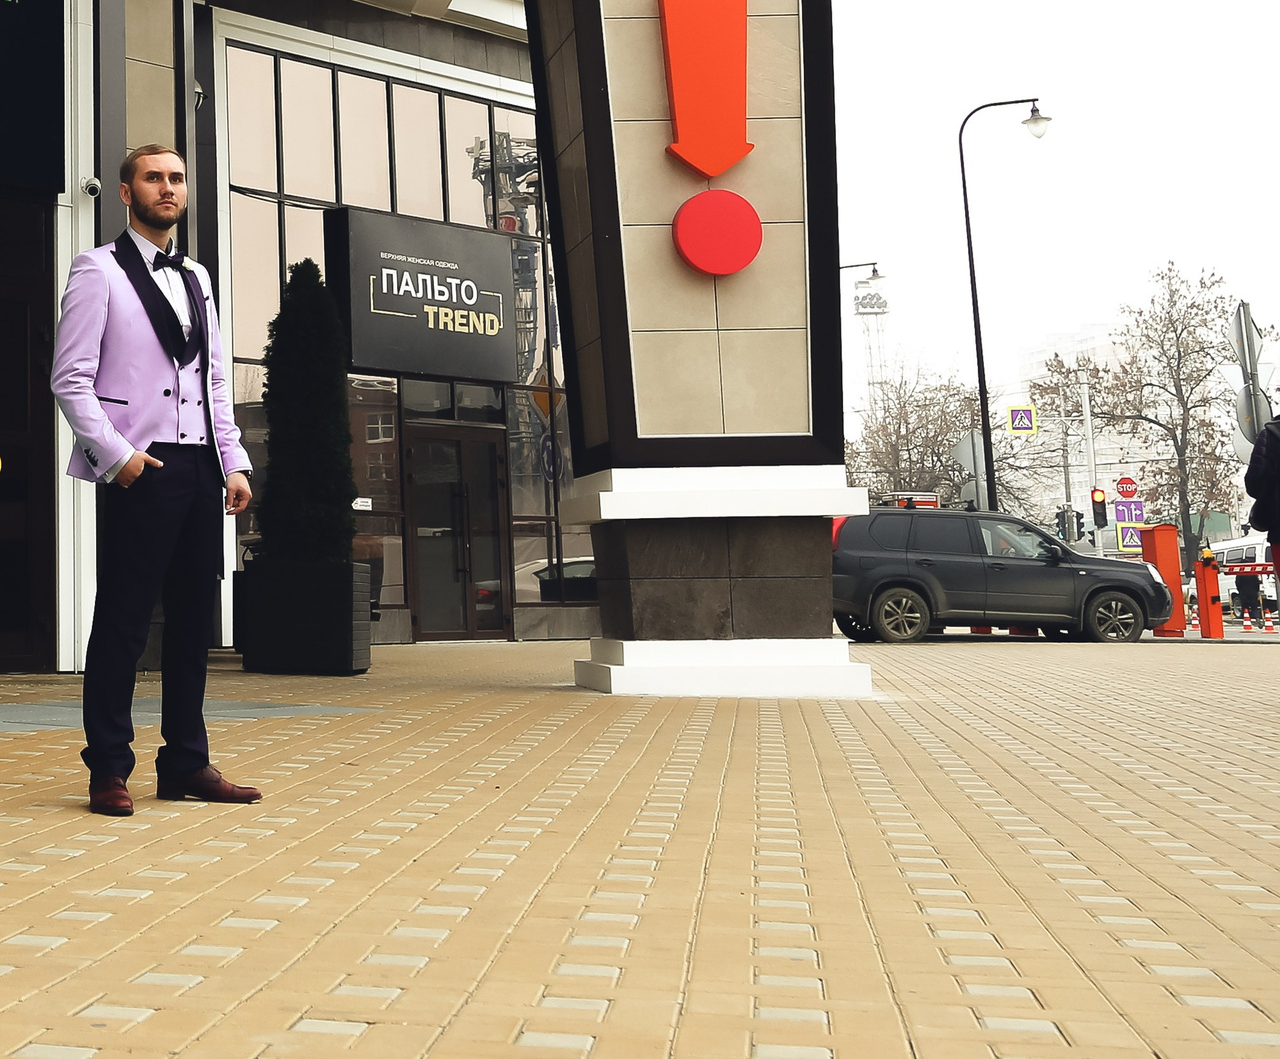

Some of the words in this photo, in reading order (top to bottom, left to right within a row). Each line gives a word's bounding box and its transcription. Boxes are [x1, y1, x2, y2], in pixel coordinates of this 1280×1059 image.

[380, 251, 407, 262] ВЕРХНЯЯ
[406, 256, 435, 266] ЖЕНСКАЯ
[434, 260, 459, 270] ОДЕЖДА
[381, 267, 478, 306] ПАЛЬТО
[423, 304, 500, 336] TREND
